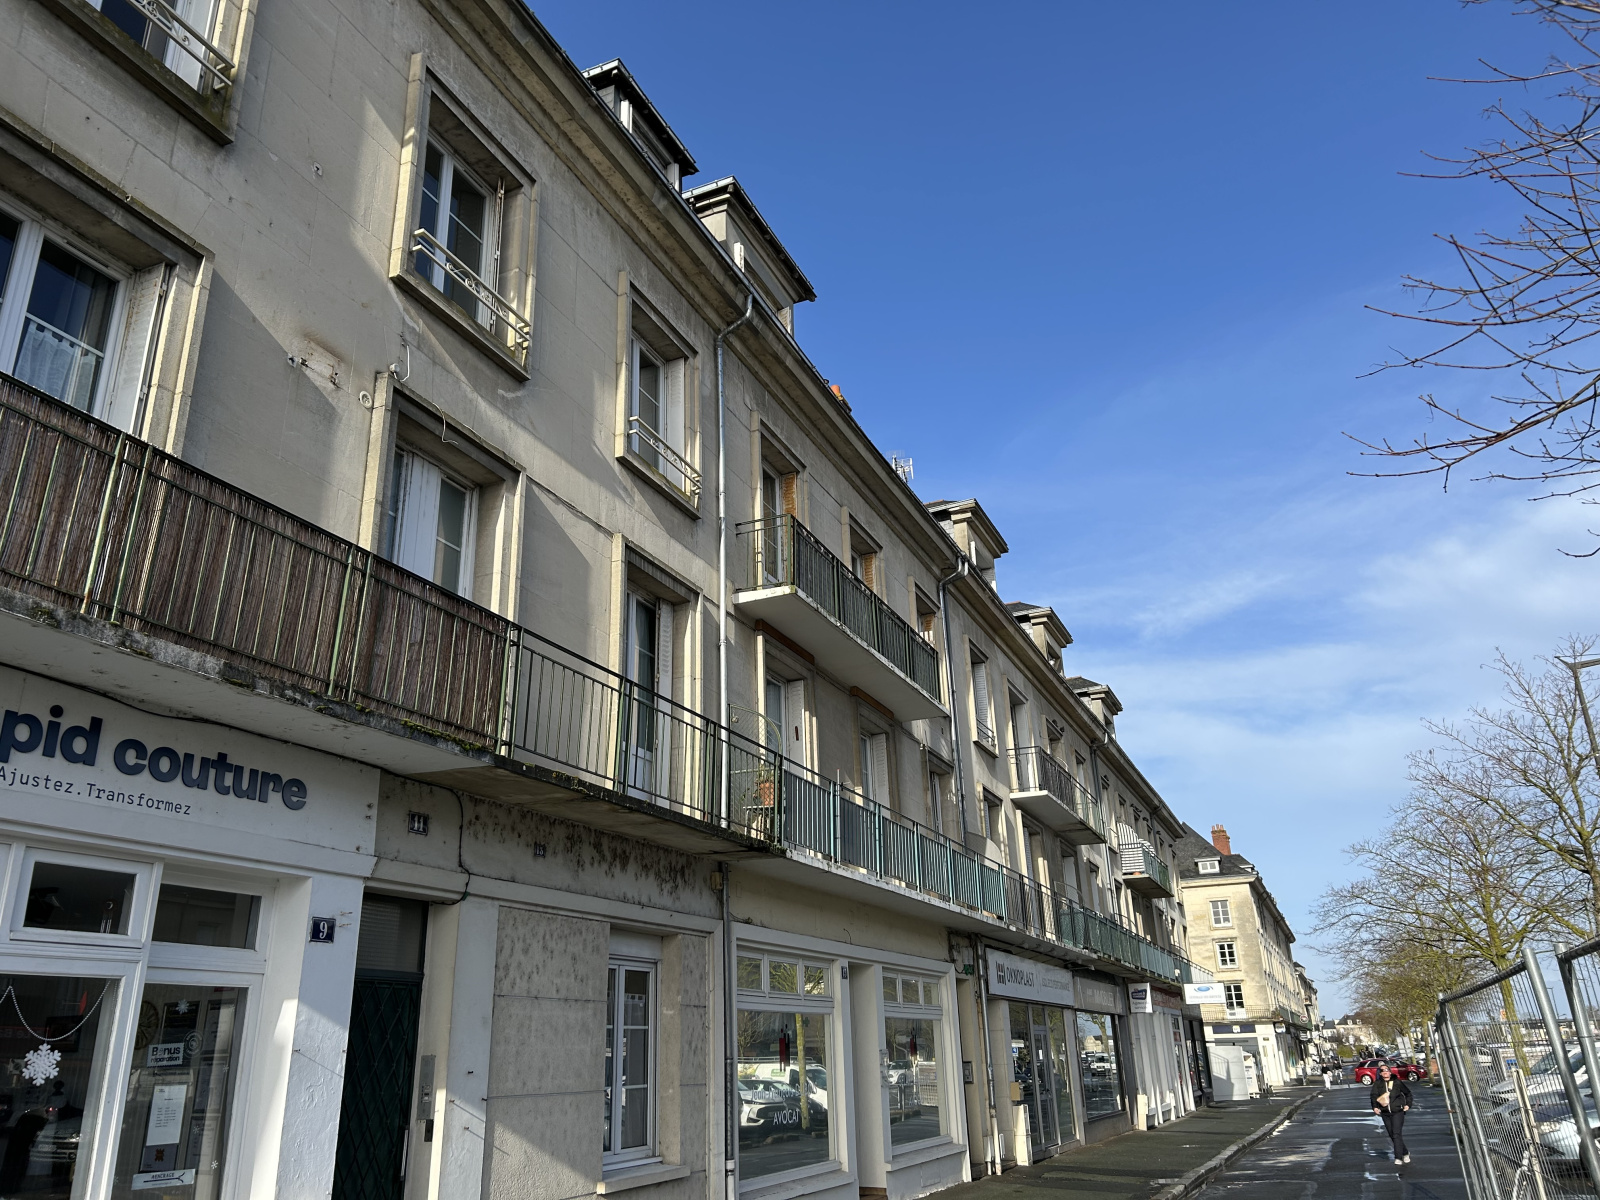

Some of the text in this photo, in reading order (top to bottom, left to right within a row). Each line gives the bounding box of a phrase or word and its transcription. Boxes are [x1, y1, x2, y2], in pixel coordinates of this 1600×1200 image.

[114, 739, 307, 812] couture
[413, 815, 424, 831] 11
[319, 921, 328, 939] 9
[773, 1108, 800, 1125] AVOCAT
